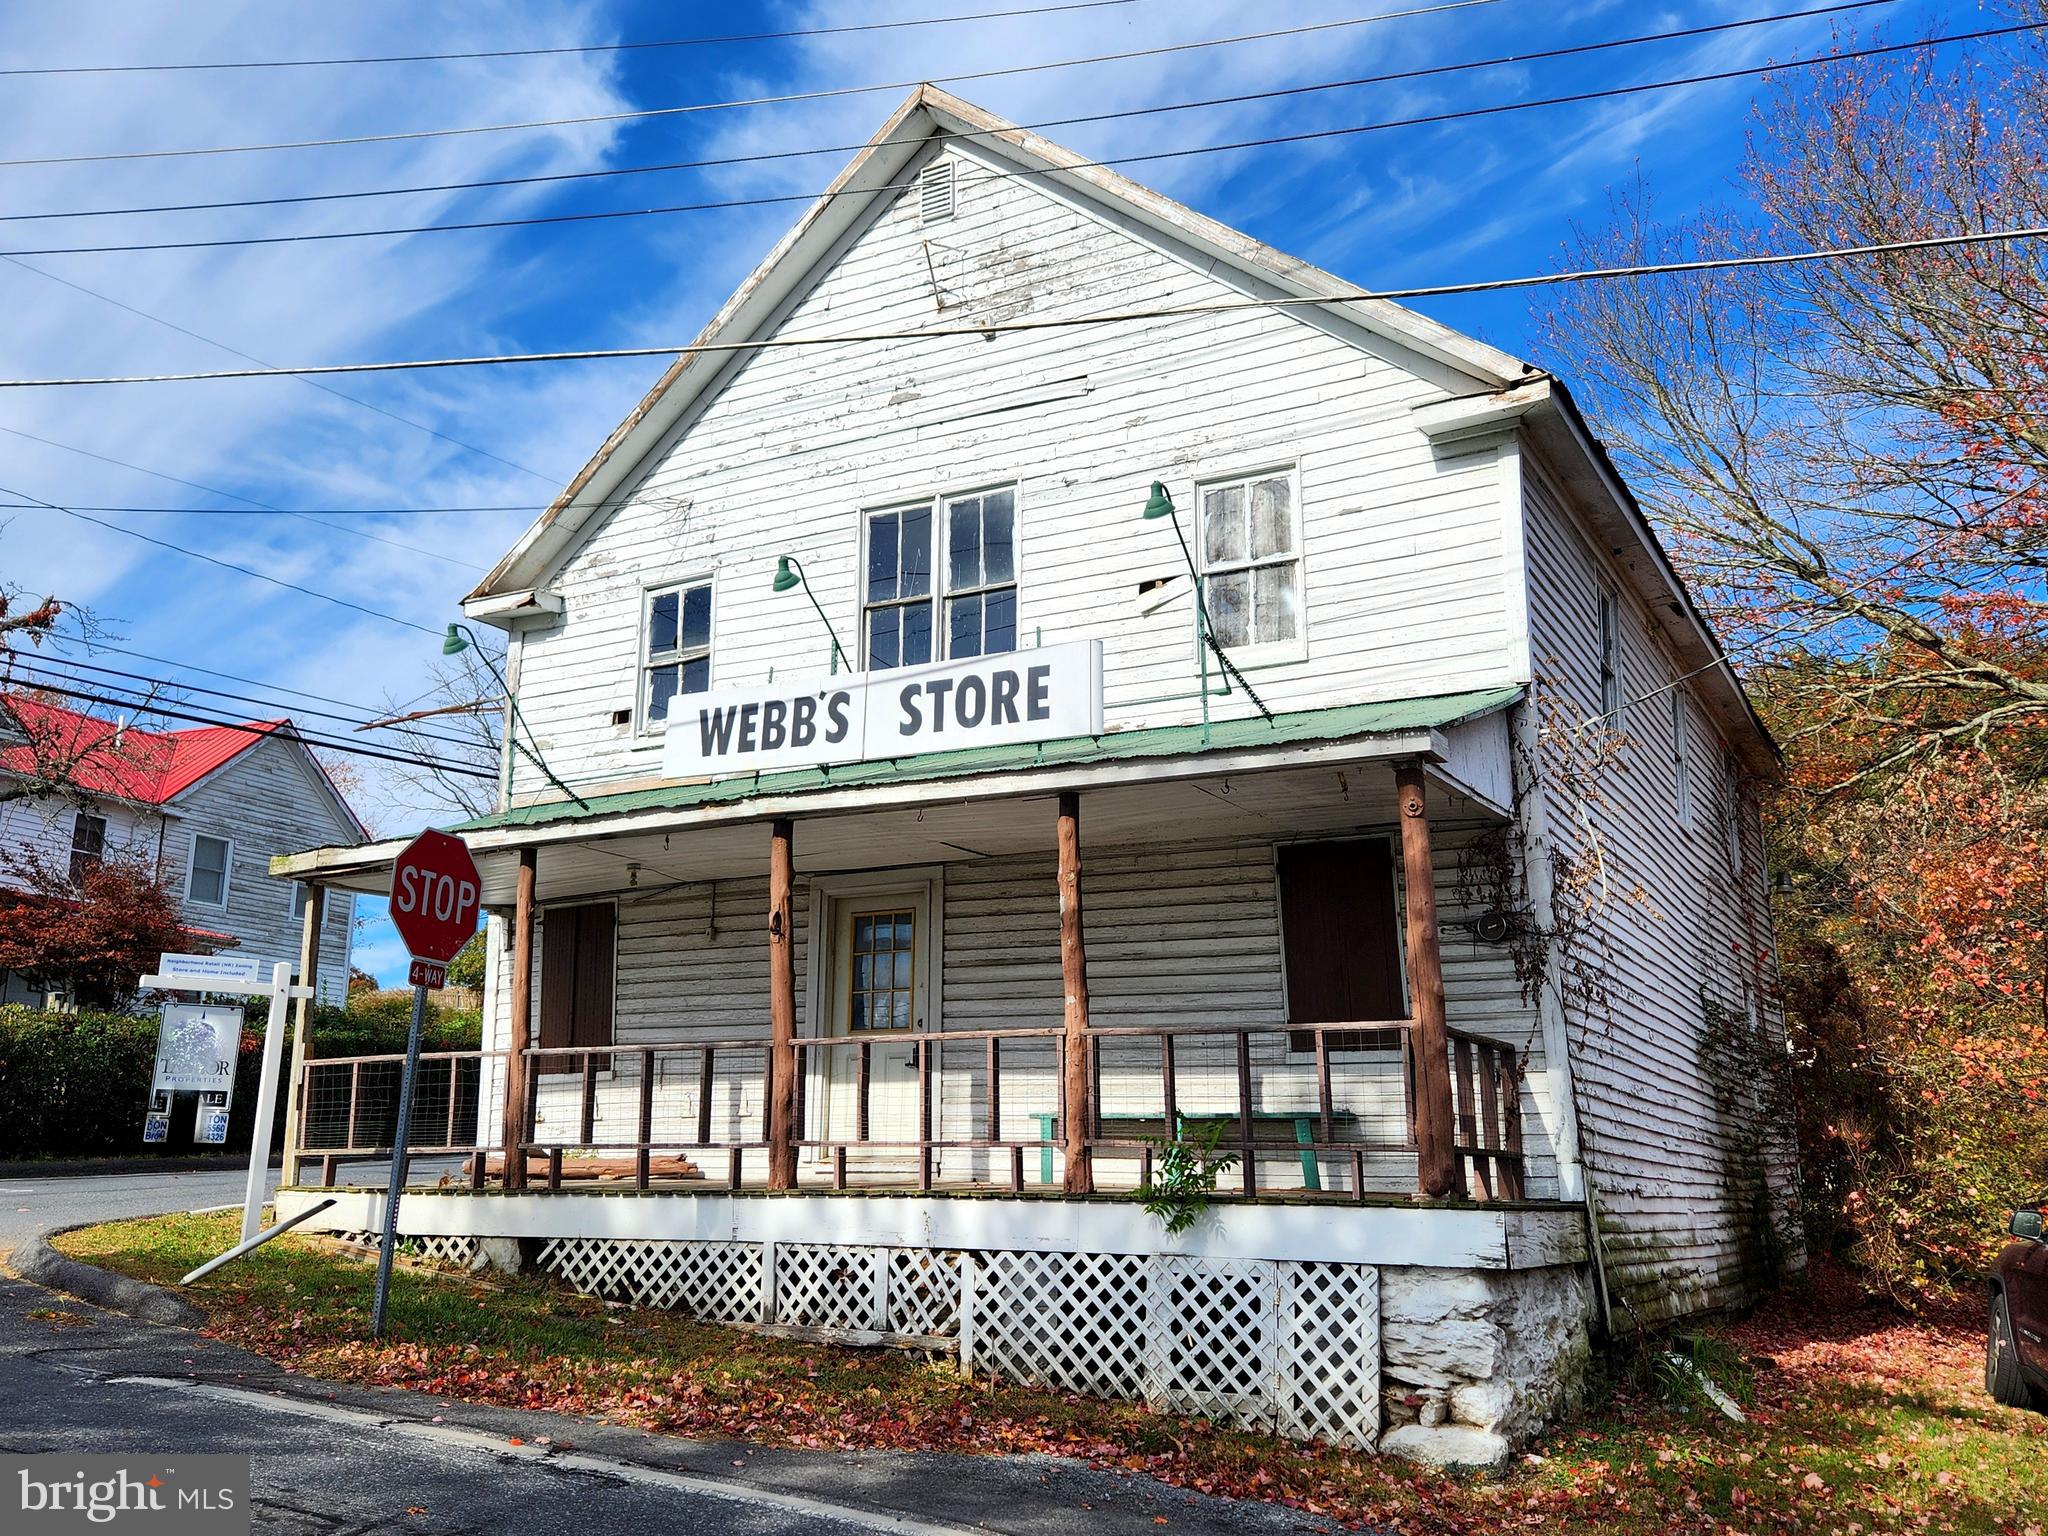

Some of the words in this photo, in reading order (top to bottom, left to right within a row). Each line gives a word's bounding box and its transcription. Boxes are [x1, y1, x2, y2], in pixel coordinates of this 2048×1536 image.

[699, 689, 851, 757] WEBB'S
[899, 664, 1051, 737] STORE
[397, 864, 476, 925] STOP
[412, 965, 444, 986] 4-WAY
